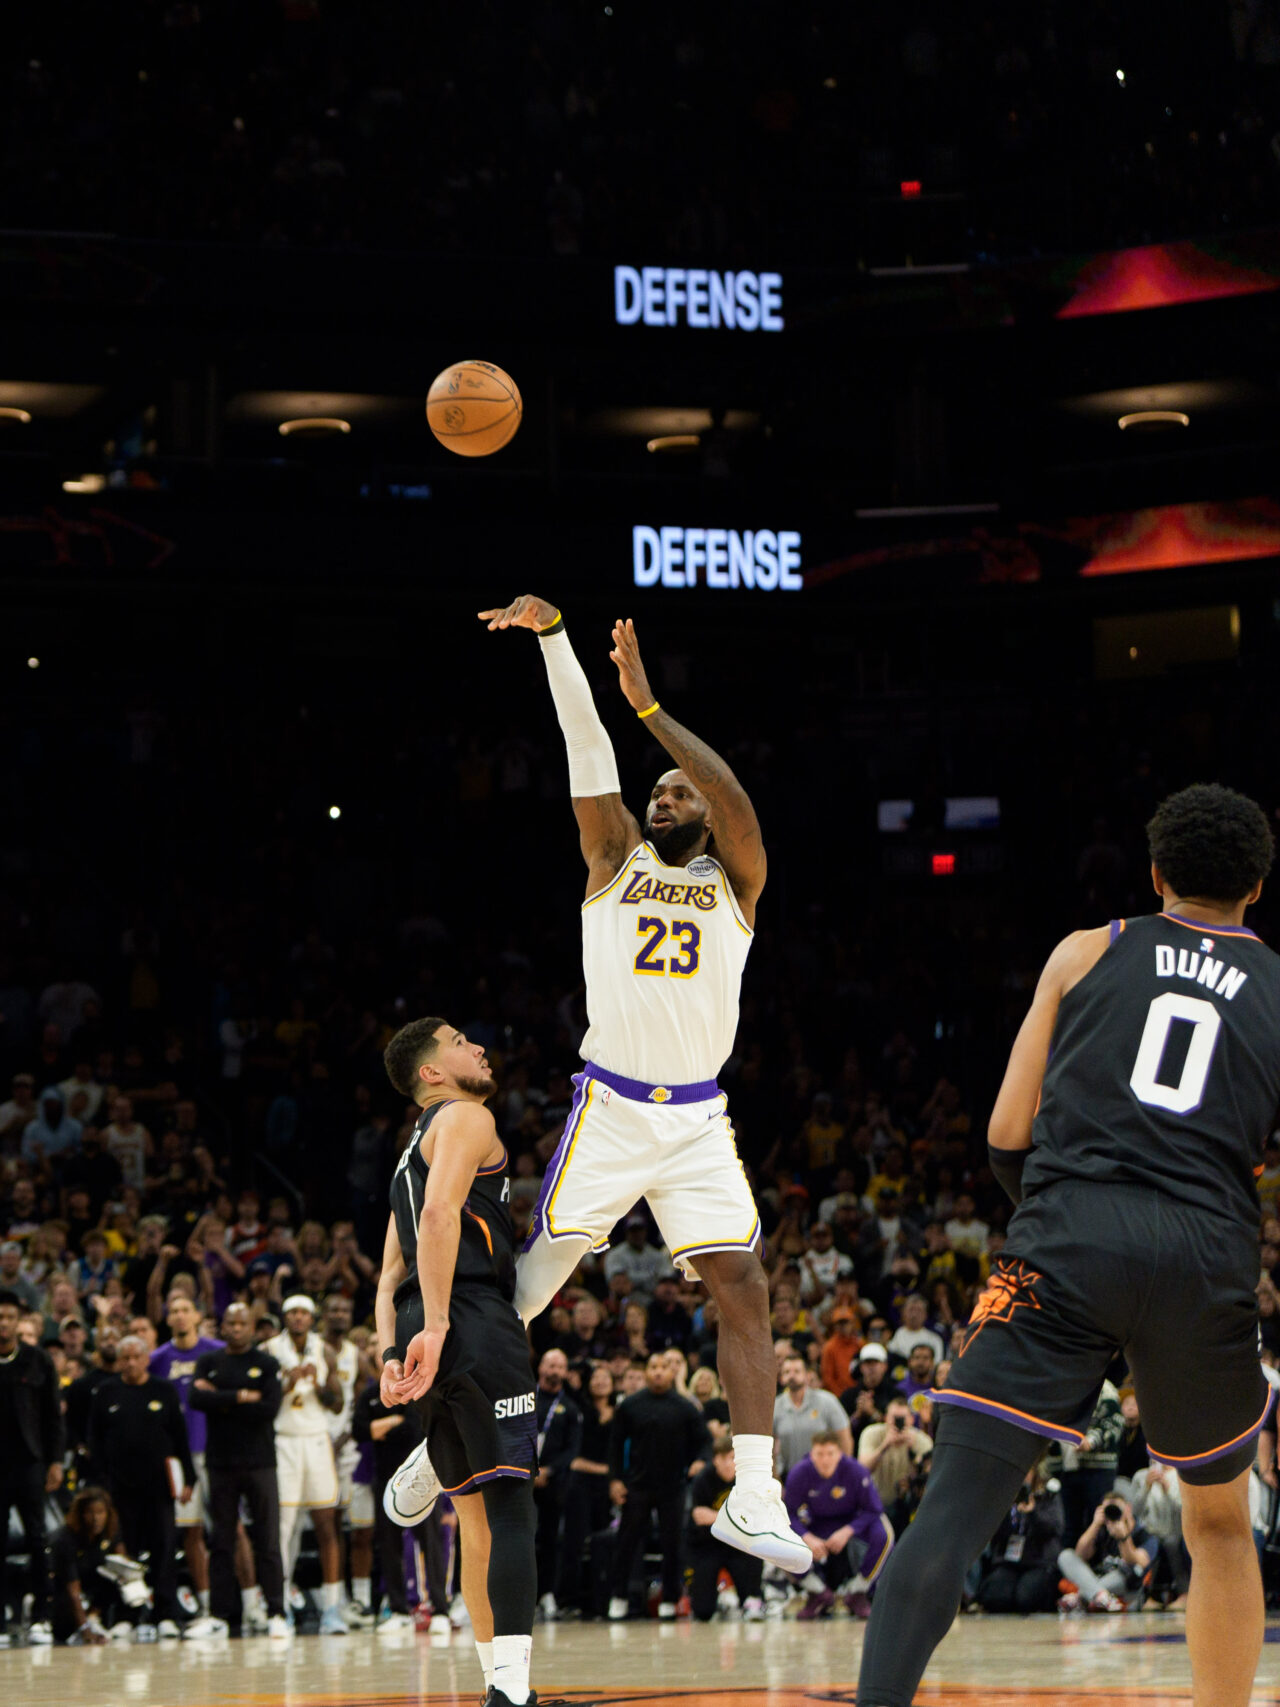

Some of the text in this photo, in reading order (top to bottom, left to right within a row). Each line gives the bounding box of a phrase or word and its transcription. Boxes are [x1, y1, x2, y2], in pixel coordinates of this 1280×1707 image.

[614, 265, 784, 331] DEFENSE
[632, 525, 803, 591] DEFENSE
[620, 870, 718, 911] LAKERS
[633, 915, 702, 979] 23
[1155, 944, 1248, 1001] DUNN
[1129, 992, 1222, 1116] 0
[494, 1390, 536, 1420] SUNS
